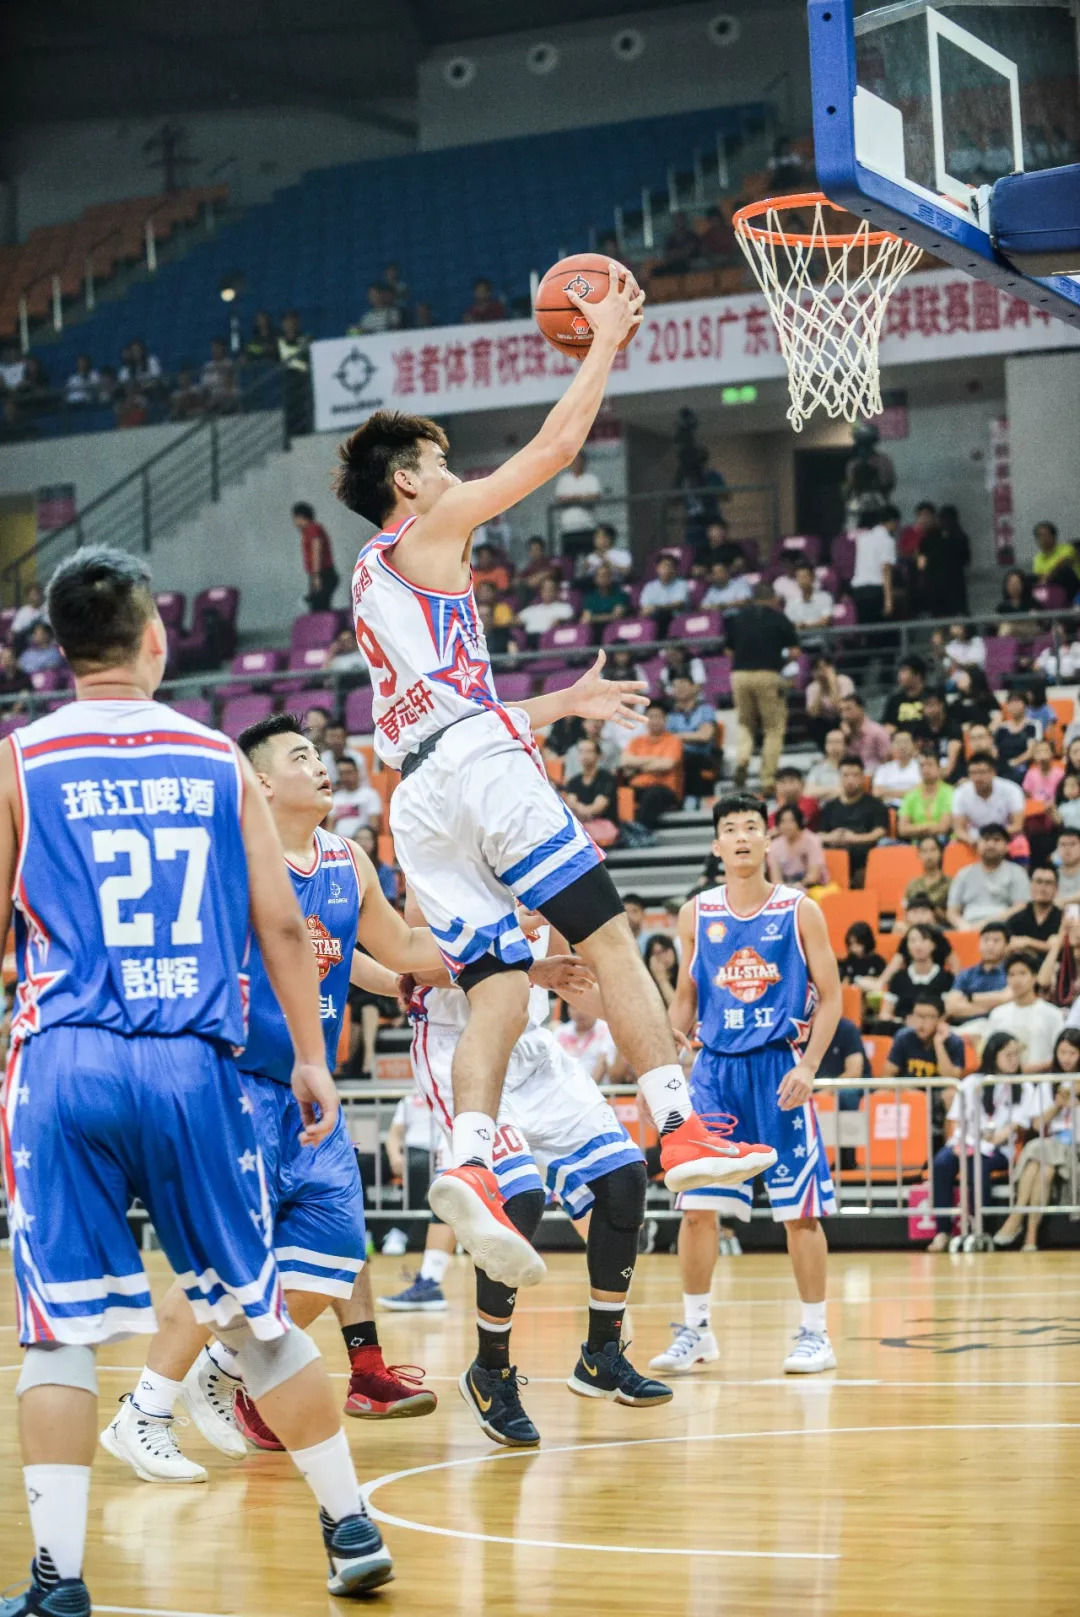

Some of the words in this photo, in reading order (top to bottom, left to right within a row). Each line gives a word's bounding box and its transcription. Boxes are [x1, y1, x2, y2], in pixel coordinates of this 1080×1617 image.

[356, 615, 398, 697] 9
[62, 777, 215, 820] 珠江啤酒
[92, 827, 211, 947] 27
[120, 956, 199, 1000] 彭辉
